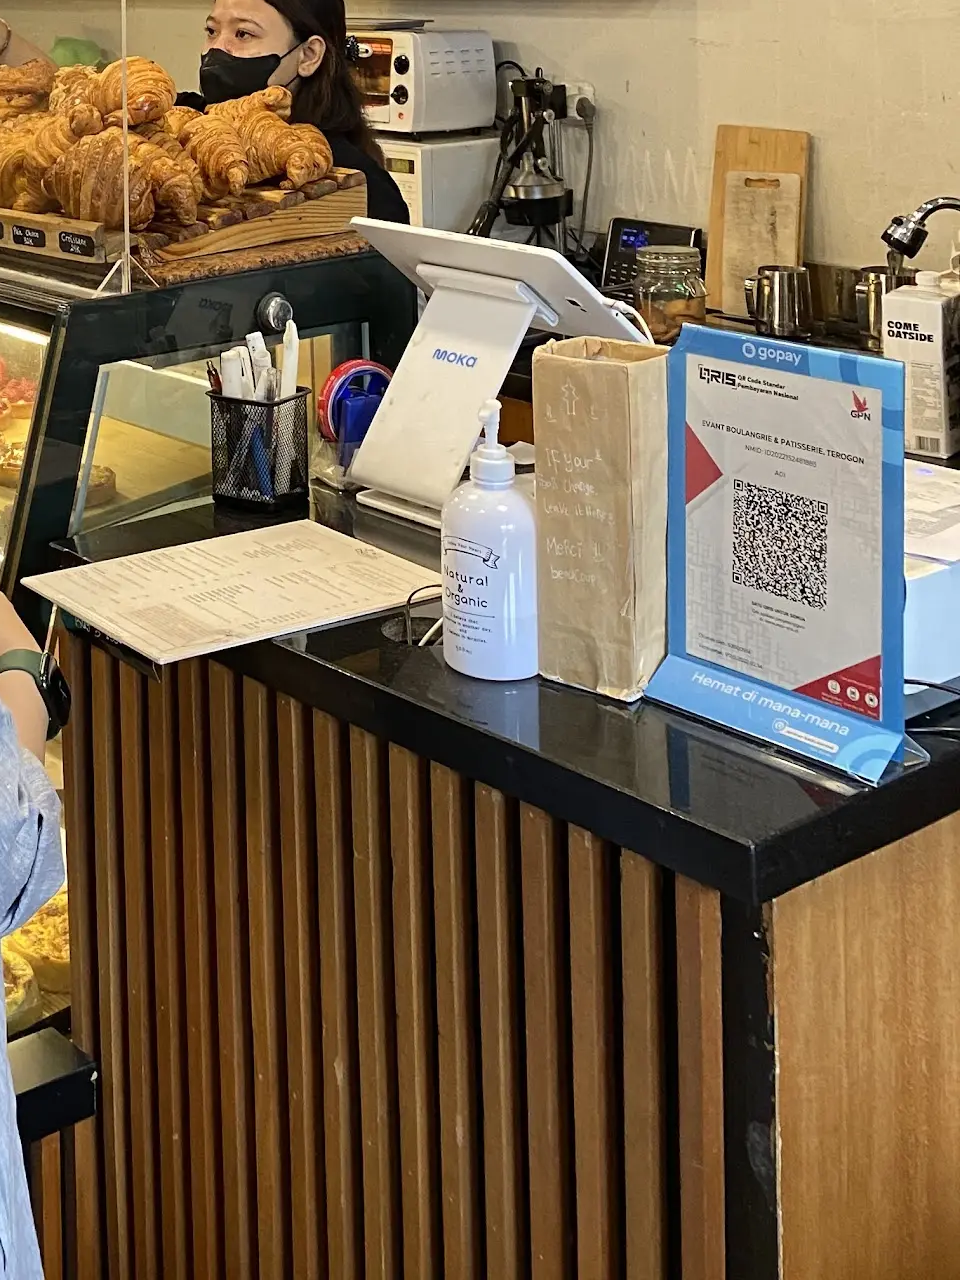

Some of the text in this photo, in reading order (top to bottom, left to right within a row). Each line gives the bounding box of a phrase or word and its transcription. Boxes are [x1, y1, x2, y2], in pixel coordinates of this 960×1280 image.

[887, 320, 920, 331] COME
[887, 329, 934, 342] OATSIDE
[757, 346, 802, 366] gopay
[698, 365, 737, 388] QRIS
[763, 380, 786, 390] Standar
[773, 390, 799, 401] Nasional
[850, 409, 872, 422] GPN
[702, 419, 725, 431] EVANT
[726, 425, 773, 443] BOULANGRIE
[773, 436, 779, 444] &
[827, 449, 865, 465] TEROGON
[443, 563, 489, 587] Natural
[445, 588, 488, 609] Organic
[457, 583, 464, 594] &
[691, 670, 742, 697] Hemat
[742, 690, 760, 703] di
[758, 694, 851, 737] mana-mana
